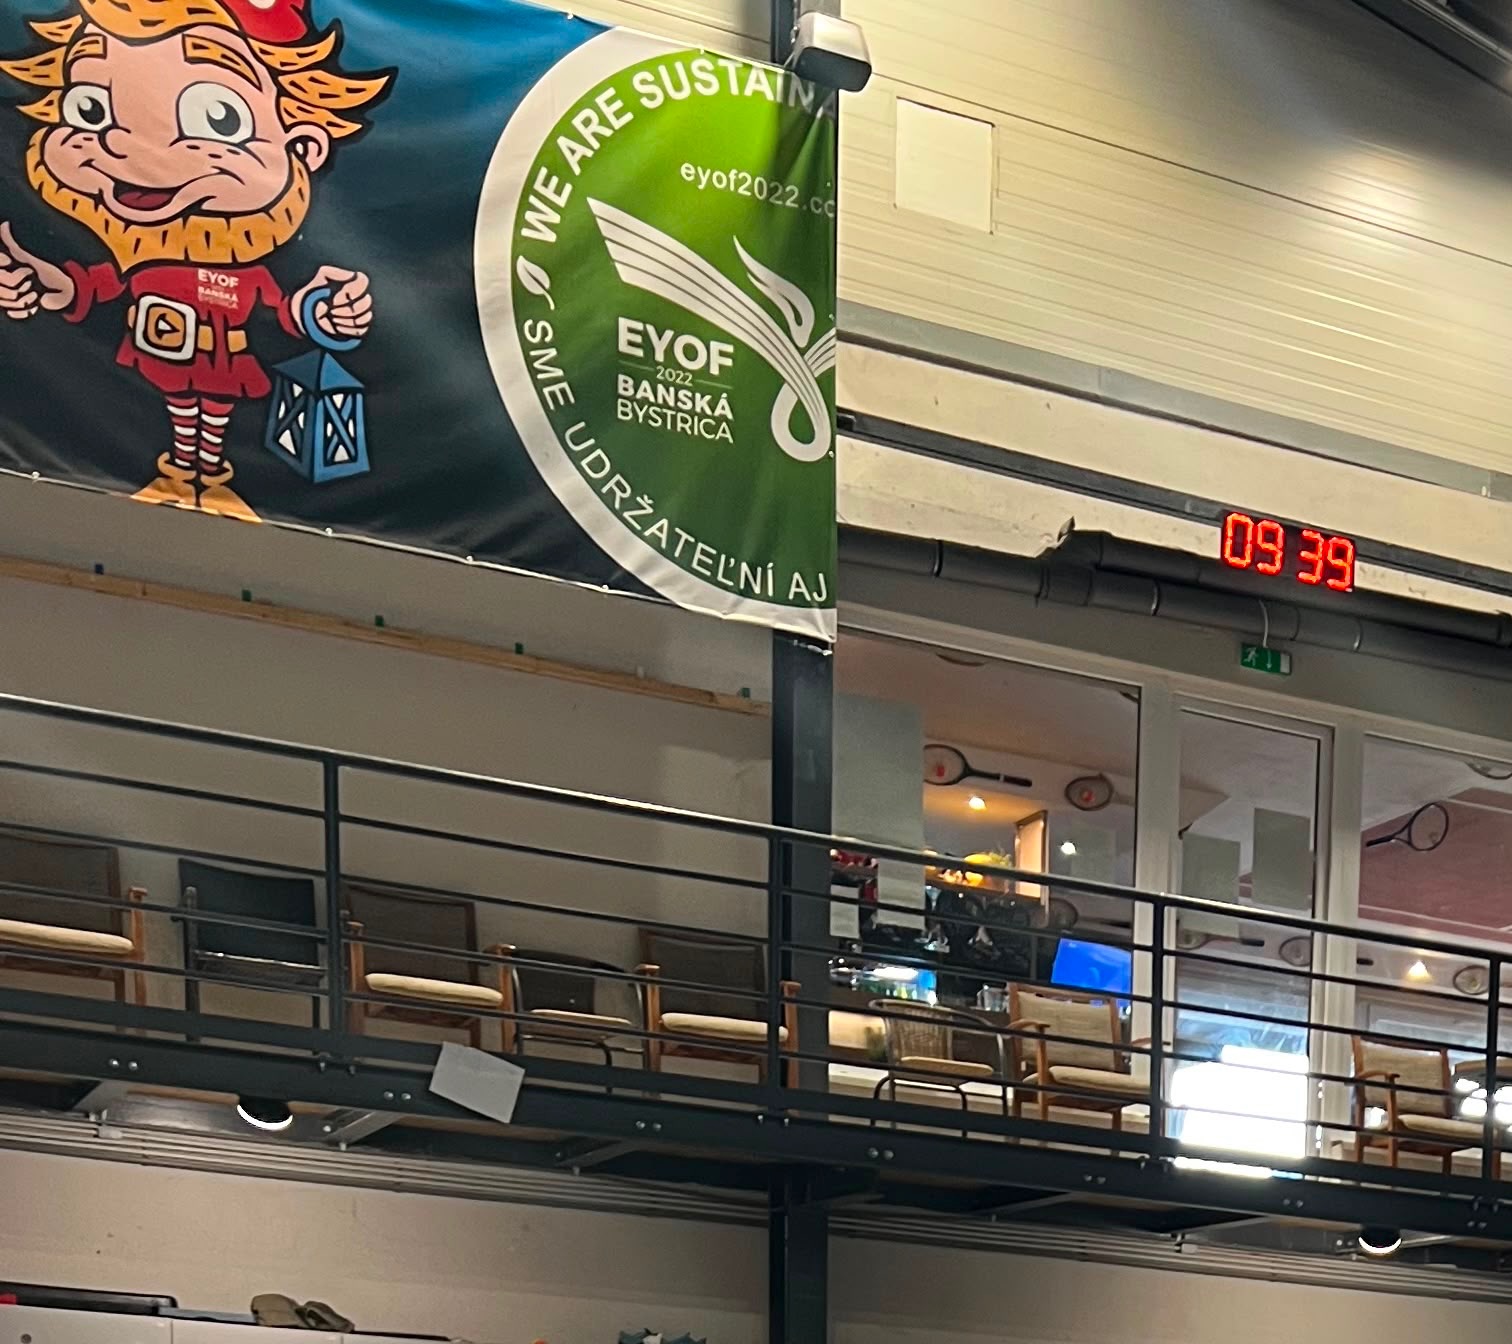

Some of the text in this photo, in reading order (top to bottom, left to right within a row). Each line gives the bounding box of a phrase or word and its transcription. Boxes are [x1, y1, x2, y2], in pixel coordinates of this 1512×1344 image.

[520, 165, 573, 243] WE
[556, 86, 635, 176] ARE
[197, 268, 240, 288] EYOF
[617, 316, 734, 376] EYOF
[617, 373, 734, 421] BANSKÁ
[655, 365, 693, 387] 2022
[617, 398, 734, 444] BYSTRICA
[523, 318, 828, 603] SME UDRŽATEĽNÍ AJ
